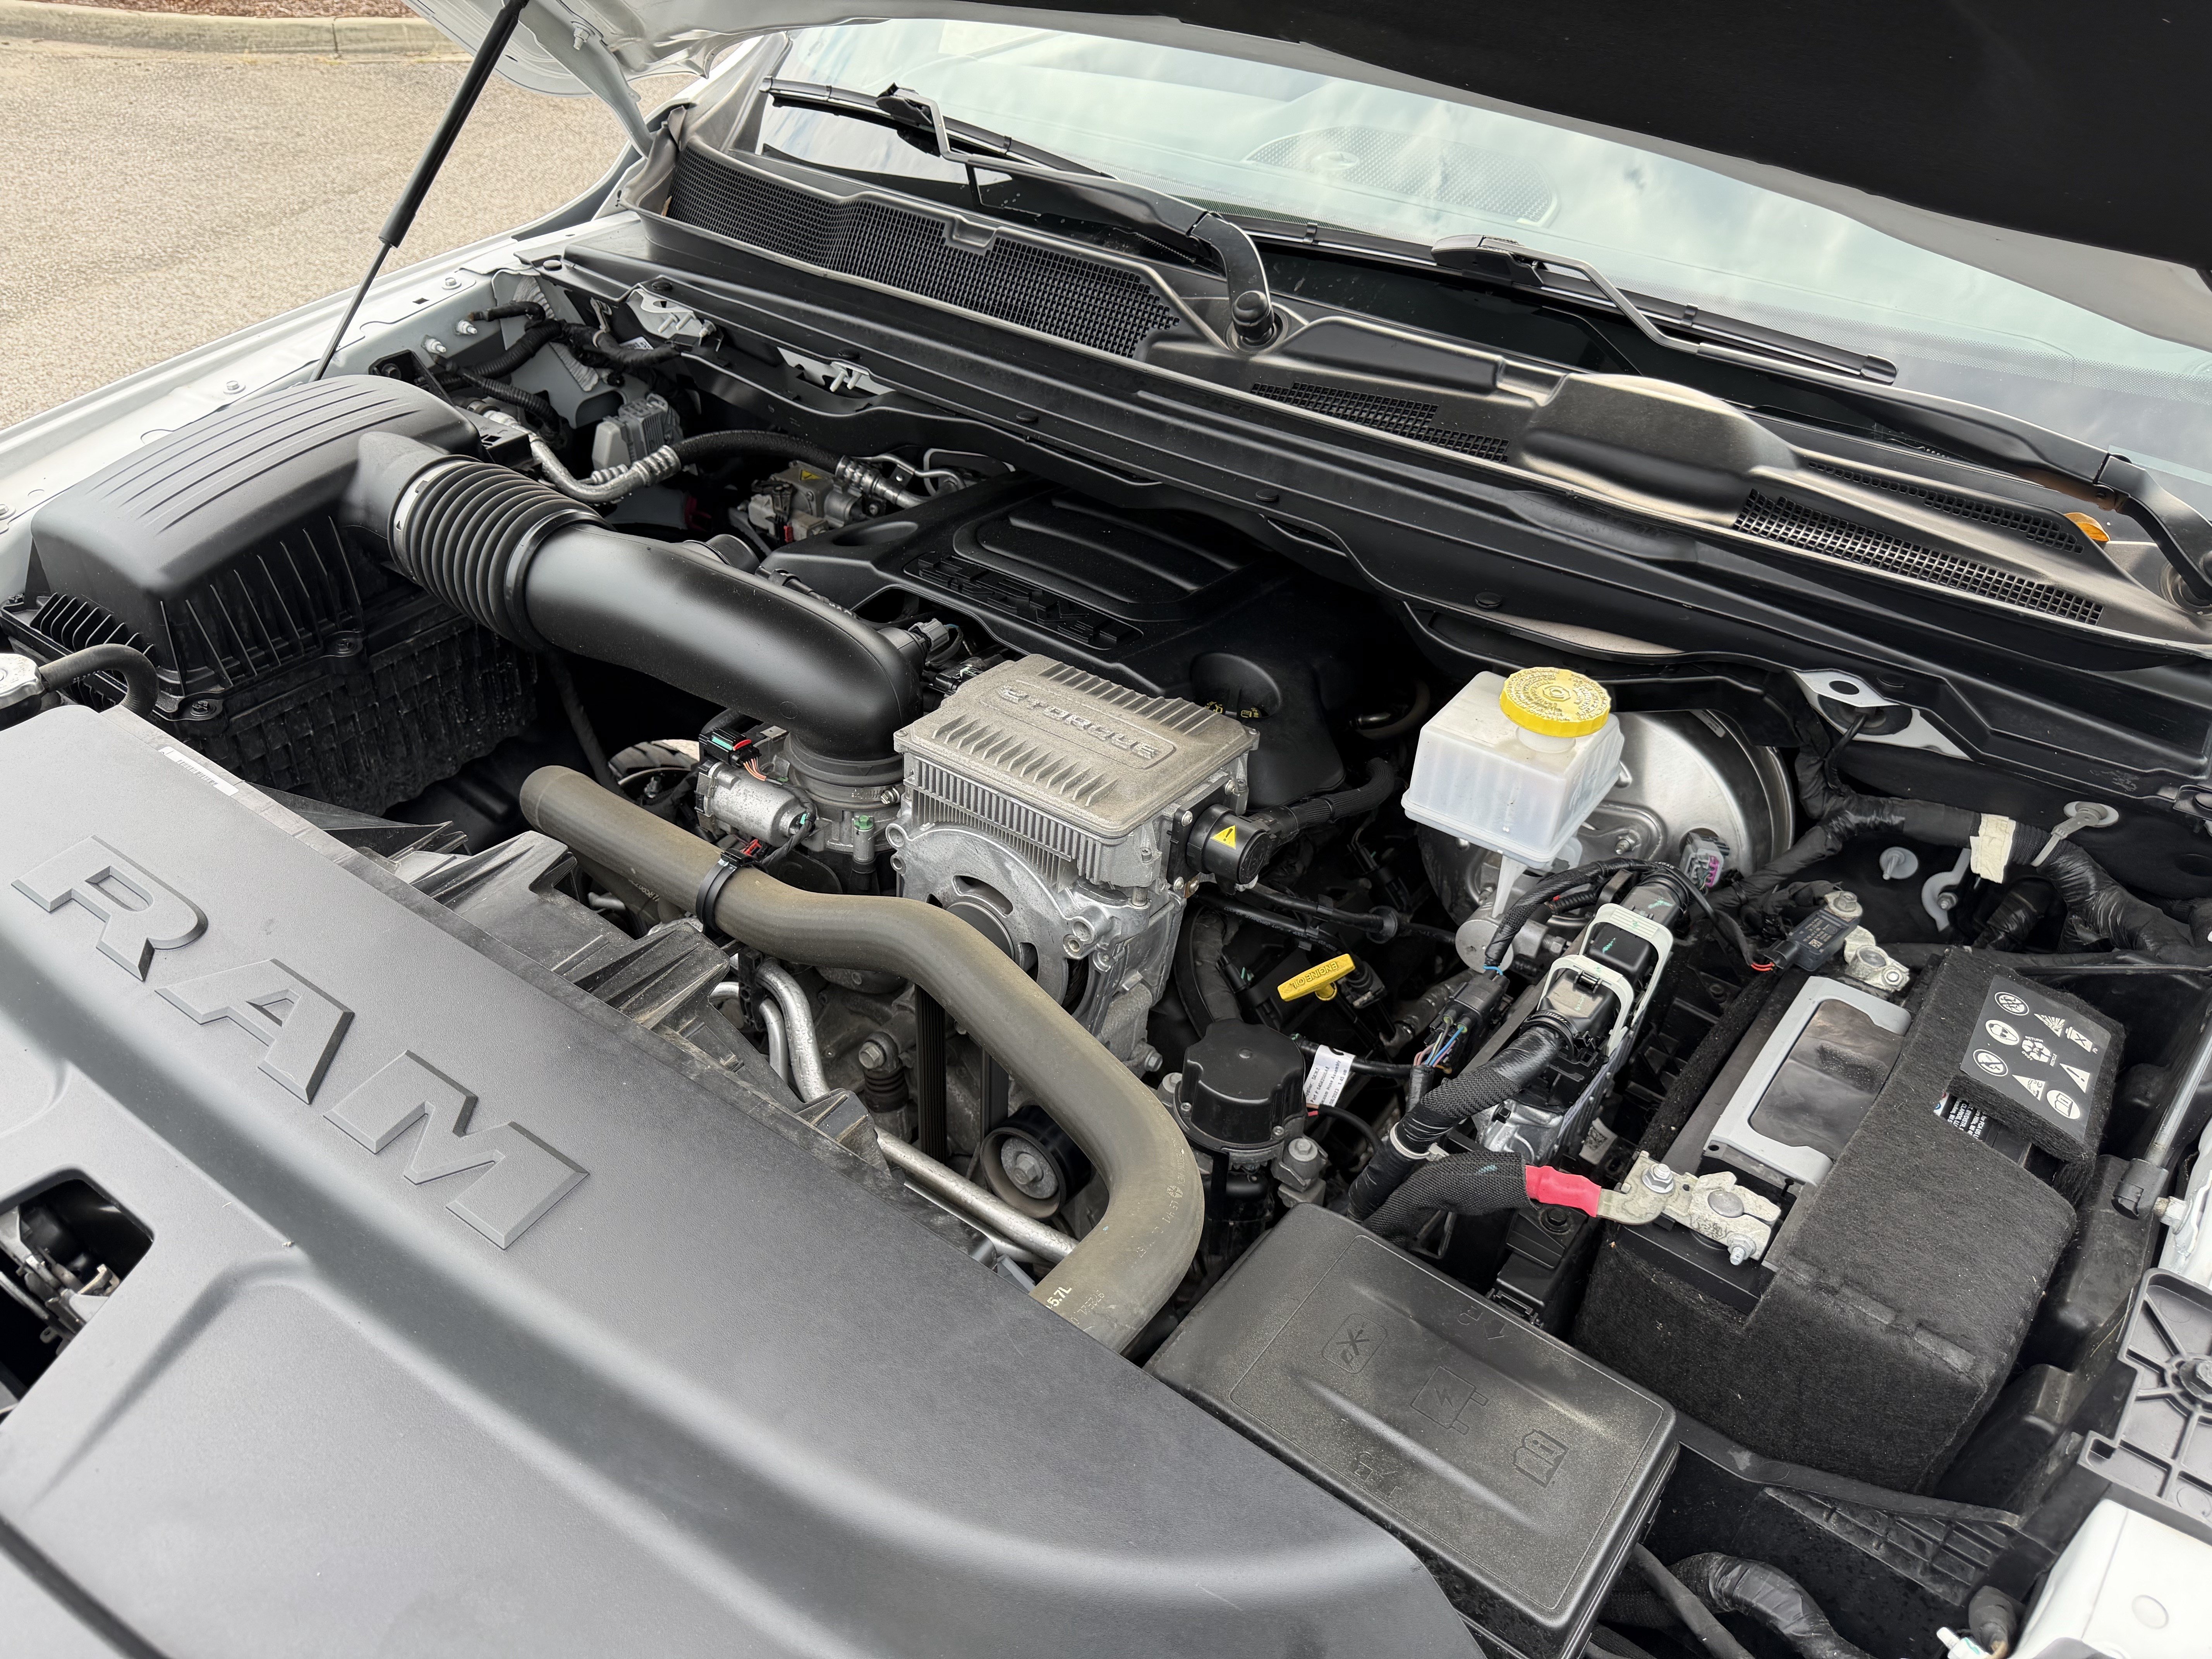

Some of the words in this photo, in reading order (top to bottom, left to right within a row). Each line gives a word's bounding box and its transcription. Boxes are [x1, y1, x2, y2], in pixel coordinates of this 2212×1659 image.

[1305, 962, 1338, 982] ENGINE
[1290, 977, 1305, 989] OIL
[11, 835, 589, 1250] RAM
